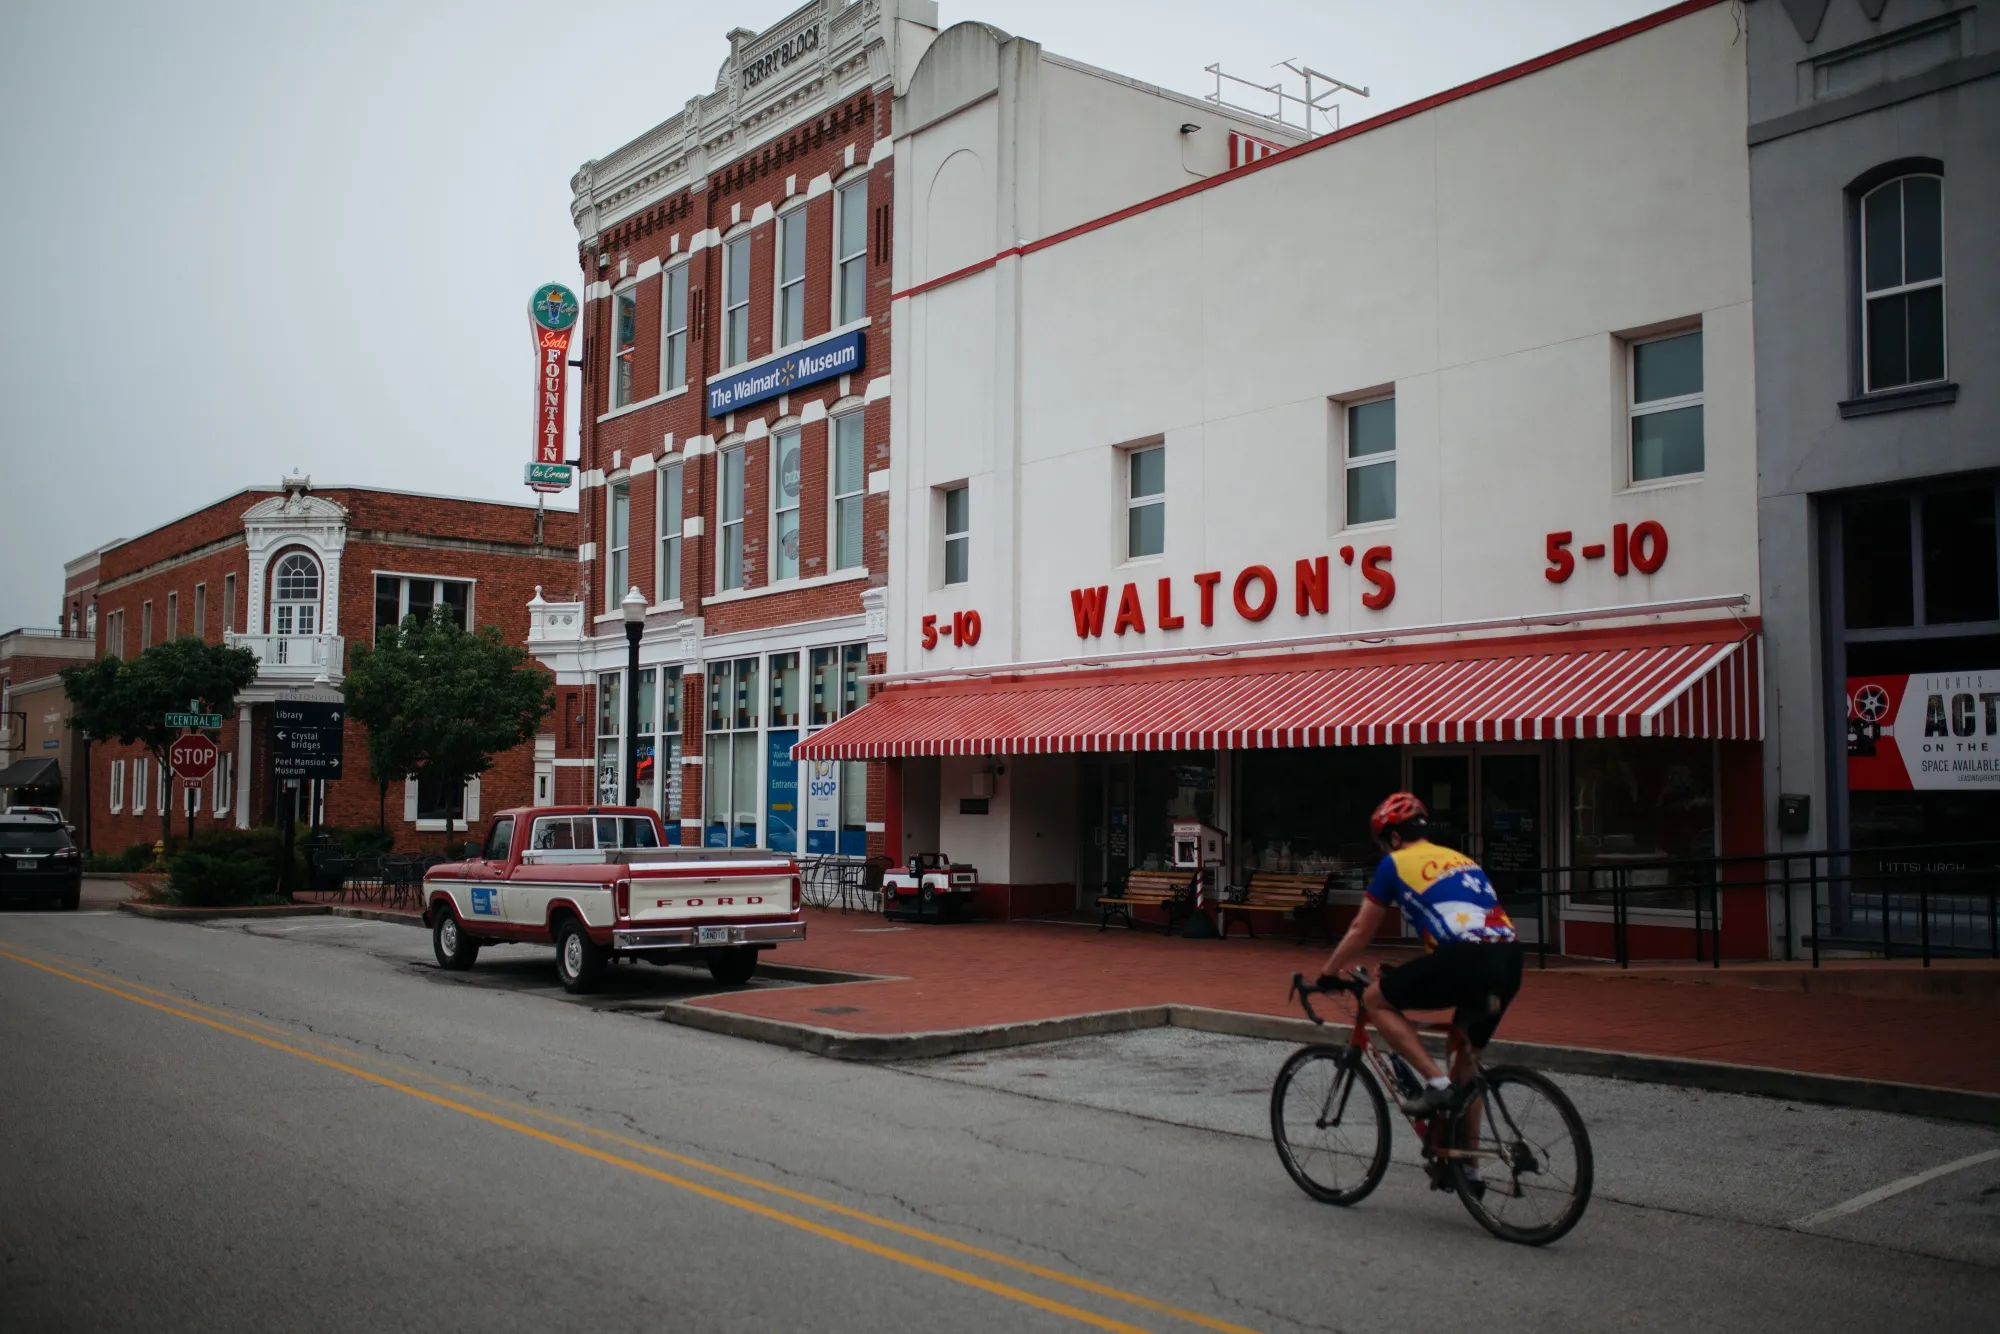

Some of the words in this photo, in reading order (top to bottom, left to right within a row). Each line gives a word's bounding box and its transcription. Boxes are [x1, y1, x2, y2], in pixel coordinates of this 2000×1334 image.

[743, 48, 780, 90] TERRY
[781, 23, 820, 67] BLOCK
[540, 331, 567, 349] Soda
[711, 388, 732, 409] The
[733, 369, 780, 401] Walmart
[797, 345, 855, 379] Museum
[543, 349, 561, 462] FOUNTAIN
[531, 466, 544, 477] Ice
[543, 466, 571, 479] Cream
[1545, 520, 1668, 584] 5-10
[1070, 545, 1396, 639] WALTON'S
[922, 609, 982, 651] 5-10
[279, 692, 341, 702] BENTONVILLE
[173, 715, 210, 726] CENTRAL
[276, 710, 303, 721] Library
[1924, 692, 2000, 737] ACT
[291, 732, 318, 743] Crystal
[291, 741, 321, 751] Bridges
[1922, 743, 1944, 752] ON
[1956, 742, 1989, 752] THE
[173, 748, 214, 765] STOP
[772, 750, 790, 759] Walmar
[275, 758, 292, 766] Peel
[294, 758, 326, 767] Mansion
[772, 760, 792, 768] Museum
[1921, 760, 1949, 772] SPACE
[1952, 758, 2000, 772] AVAILABLE
[275, 767, 306, 775] Museum
[771, 779, 798, 789] Entrance
[811, 781, 836, 796] SHOP
[1878, 860, 1966, 873] ITTSURGH
[656, 896, 763, 908] FORD
